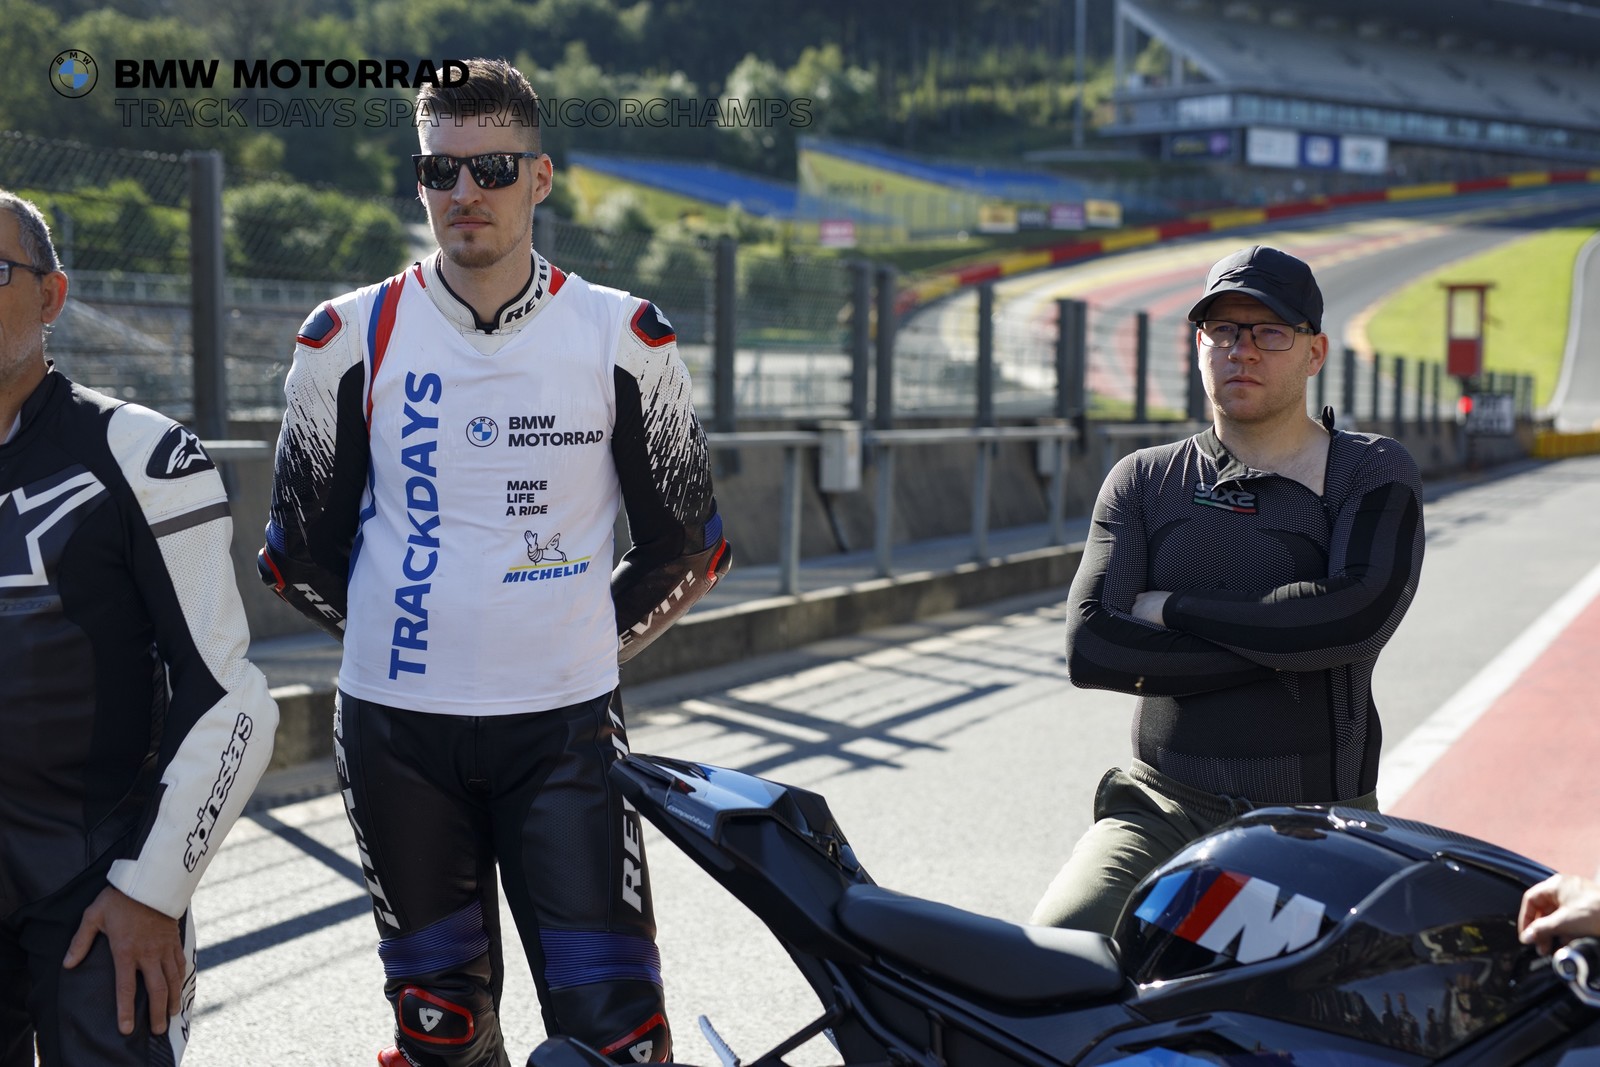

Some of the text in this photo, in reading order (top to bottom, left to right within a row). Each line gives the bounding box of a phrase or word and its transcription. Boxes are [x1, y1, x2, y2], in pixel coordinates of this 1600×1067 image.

[508, 415, 556, 430] BMW
[508, 430, 604, 447] MOTORRAD
[507, 480, 548, 491] MAKE
[506, 493, 535, 504] LIFE
[505, 504, 549, 517] A RIDE
[388, 371, 443, 681] TRACKDAYS
[502, 561, 590, 583] MICHELIN
[183, 712, 254, 873] alpinestars
[1195, 876, 1327, 965] M
